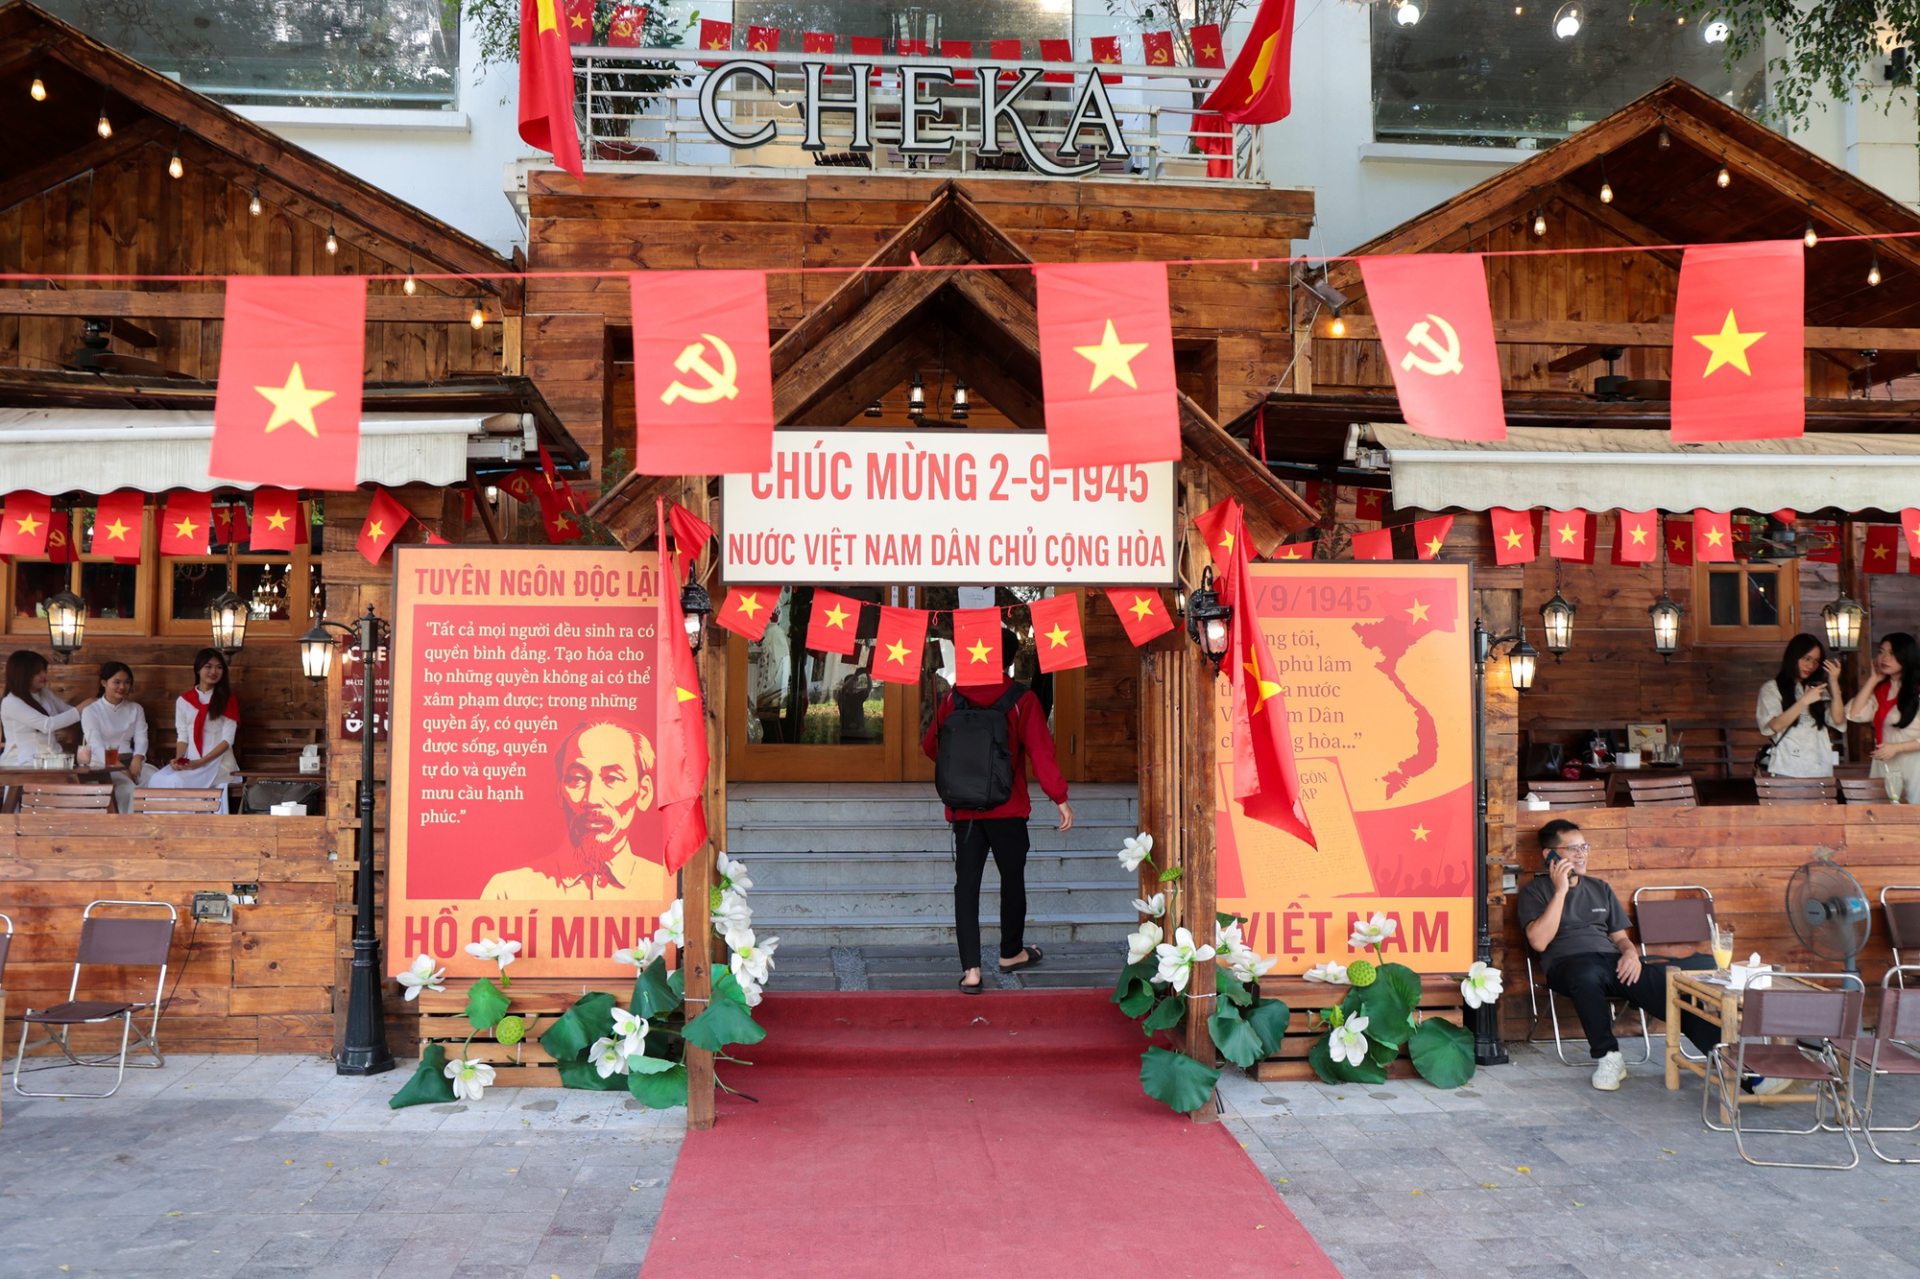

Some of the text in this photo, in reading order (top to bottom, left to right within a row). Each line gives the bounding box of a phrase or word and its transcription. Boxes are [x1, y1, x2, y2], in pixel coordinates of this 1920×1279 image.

[699, 59, 1131, 176] CHEKA
[751, 440, 1149, 502] CHÚC MỪNG 2-9-1945
[729, 526, 1166, 572] NƯỚC VIỆT NAM DÂN CHỦ CỘNG HÒA
[415, 563, 490, 596] TUYÊN
[500, 564, 565, 596] NGÔN
[574, 565, 620, 602] ĐỘC
[1256, 585, 1371, 612] /9/1945
[458, 621, 474, 637] cả
[478, 622, 506, 640] mọi
[510, 622, 550, 640] người
[554, 622, 580, 638] đều
[584, 622, 616, 638] sinh
[619, 625, 634, 638] ra
[638, 624, 654, 638] có
[1292, 630, 1320, 650] tôi,
[424, 644, 469, 662] quyền
[473, 646, 506, 660] bình
[554, 646, 582, 664] Tạo
[587, 646, 614, 661] hóa
[618, 646, 644, 661] cho
[1279, 655, 1352, 674] phủ lâm
[424, 666, 651, 687] họ những quyền không ai có thể
[1297, 683, 1341, 698] nước
[423, 692, 637, 710] xâm phạm được; trong những
[422, 714, 558, 733] quyền ấy, có quyền
[1308, 707, 1344, 723] Dân
[422, 737, 547, 756] được sống, quyền
[422, 762, 526, 780] tự do và quyền
[1299, 770, 1328, 784] GÔN
[421, 784, 524, 803] mưu cầu hạnh
[1301, 787, 1318, 802] ẬP
[420, 809, 466, 826] phúc.”
[404, 905, 458, 958] HỒ
[472, 908, 538, 958] CHÍ
[1232, 902, 1333, 962] VIỆT
